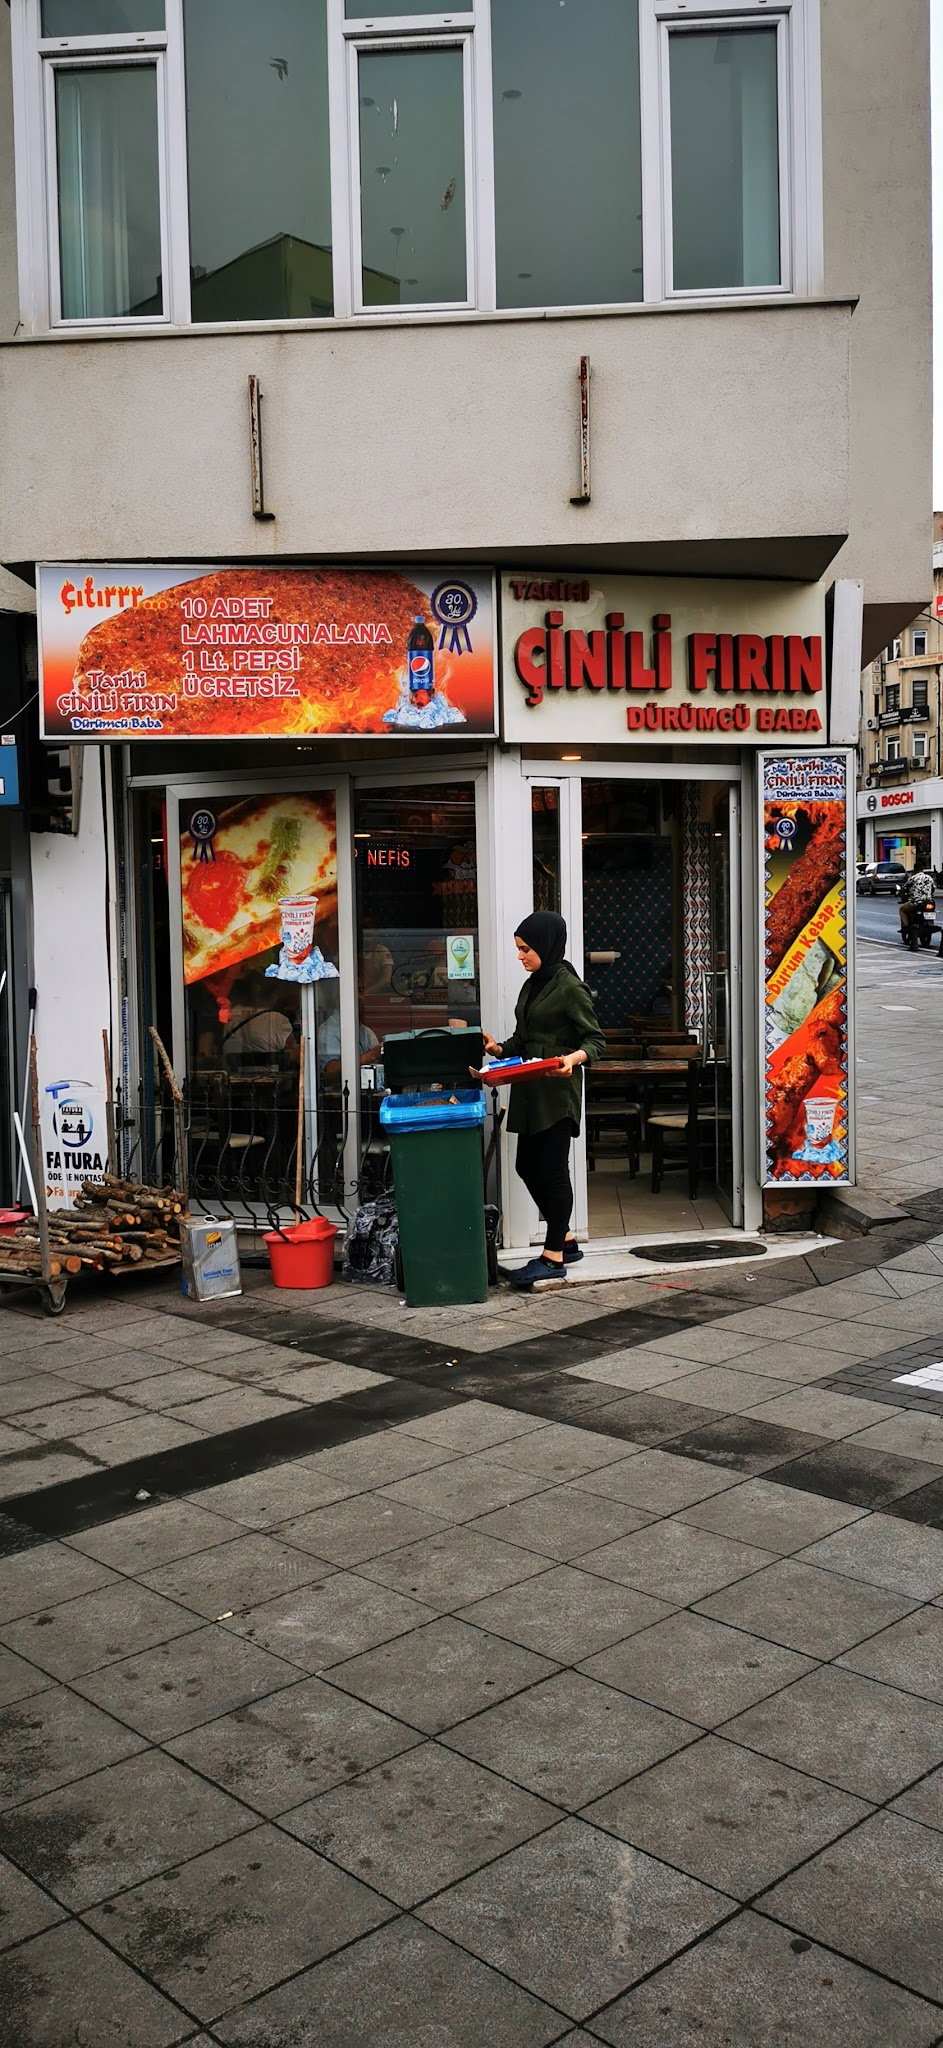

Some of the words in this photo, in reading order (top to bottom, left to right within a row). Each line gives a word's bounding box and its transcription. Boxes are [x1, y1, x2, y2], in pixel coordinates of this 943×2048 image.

[509, 579, 590, 603] TARİHİ
[181, 598, 208, 618] 10
[211, 598, 273, 618] ADET
[181, 624, 309, 644] LAHMACUN
[313, 623, 393, 644] ALANA
[182, 650, 194, 671] 1
[200, 651, 229, 671] Lt.
[234, 646, 300, 671] PEPSİ
[514, 610, 672, 707] ÇİNİLİ
[687, 632, 822, 693] FIRIN
[87, 669, 146, 688] Tarihi
[183, 672, 300, 697] ÜCRETSİZ.
[57, 690, 117, 715] ÇİNİLİ
[121, 693, 178, 711] FIRIN
[72, 717, 128, 730] Dürümcü
[131, 716, 163, 730] Baba
[626, 702, 751, 730] DÜRÜMCÜ
[755, 707, 822, 731] BABA
[787, 760, 824, 771] Tarihi
[767, 774, 804, 788] ÇİNİLİ
[808, 775, 844, 786] FIRIN
[776, 790, 812, 798] Dürümcü
[814, 789, 835, 797] Baba
[881, 791, 914, 807] BOSCH
[46, 1151, 103, 1171] FATURA
[48, 1171, 72, 1182] ÖDEE
